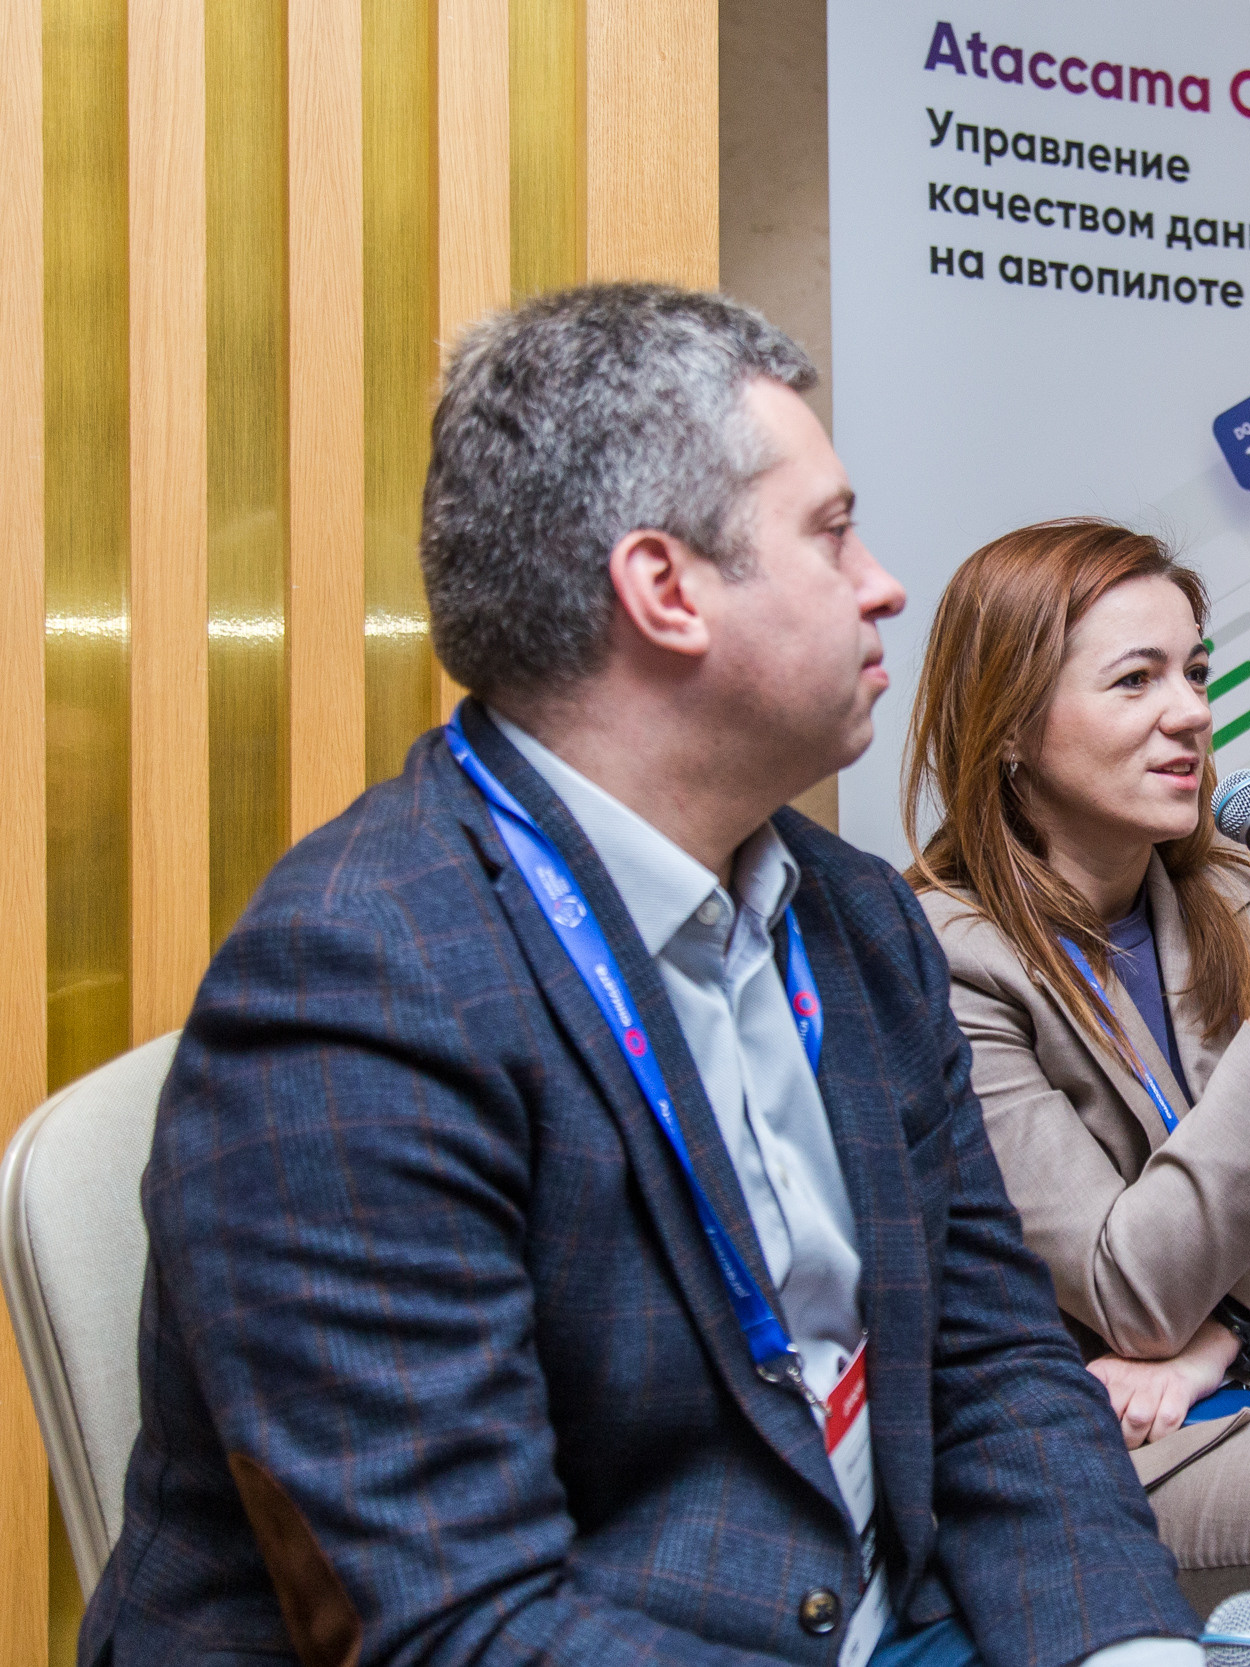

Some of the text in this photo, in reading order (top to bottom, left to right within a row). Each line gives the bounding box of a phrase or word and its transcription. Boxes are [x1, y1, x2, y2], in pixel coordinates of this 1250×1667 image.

[924, 21, 1210, 113] Ataccama
[927, 108, 1190, 183] Управление
[929, 182, 1154, 239] качеством
[930, 246, 1244, 308] на автопилоте
